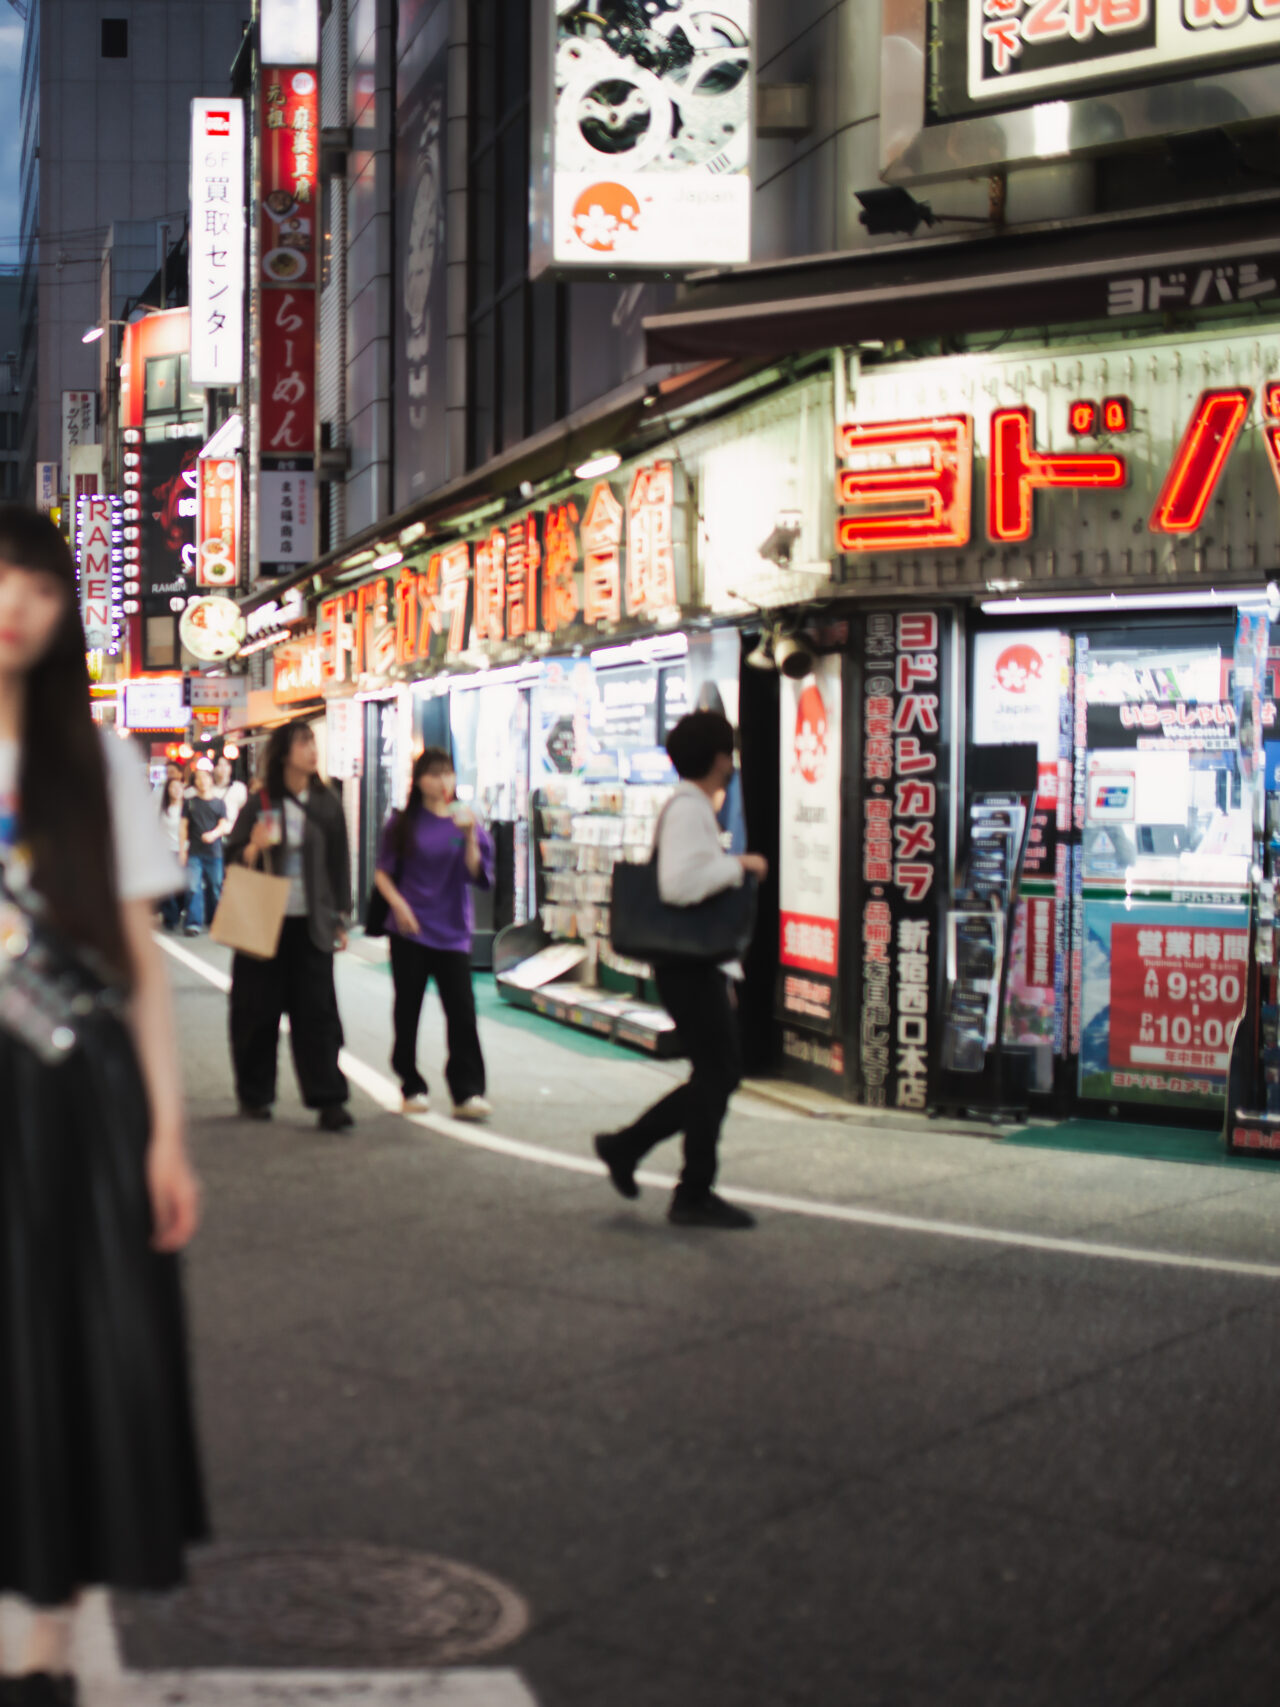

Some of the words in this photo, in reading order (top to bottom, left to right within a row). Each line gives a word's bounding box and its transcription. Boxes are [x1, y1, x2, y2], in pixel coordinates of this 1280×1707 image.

[205, 152, 229, 168] 6F
[204, 176, 231, 368] 買取センター
[1107, 264, 1277, 316] ヨドバシ
[272, 294, 306, 449] らーめん
[85, 501, 110, 625] RAMEN
[893, 611, 939, 901] ヨドバシカメラ
[1137, 930, 1249, 962] 営業時間
[1167, 971, 1240, 1003] 9:30
[895, 918, 930, 1108] 新宿西口本店
[1165, 1050, 1217, 1067] 年中無休
